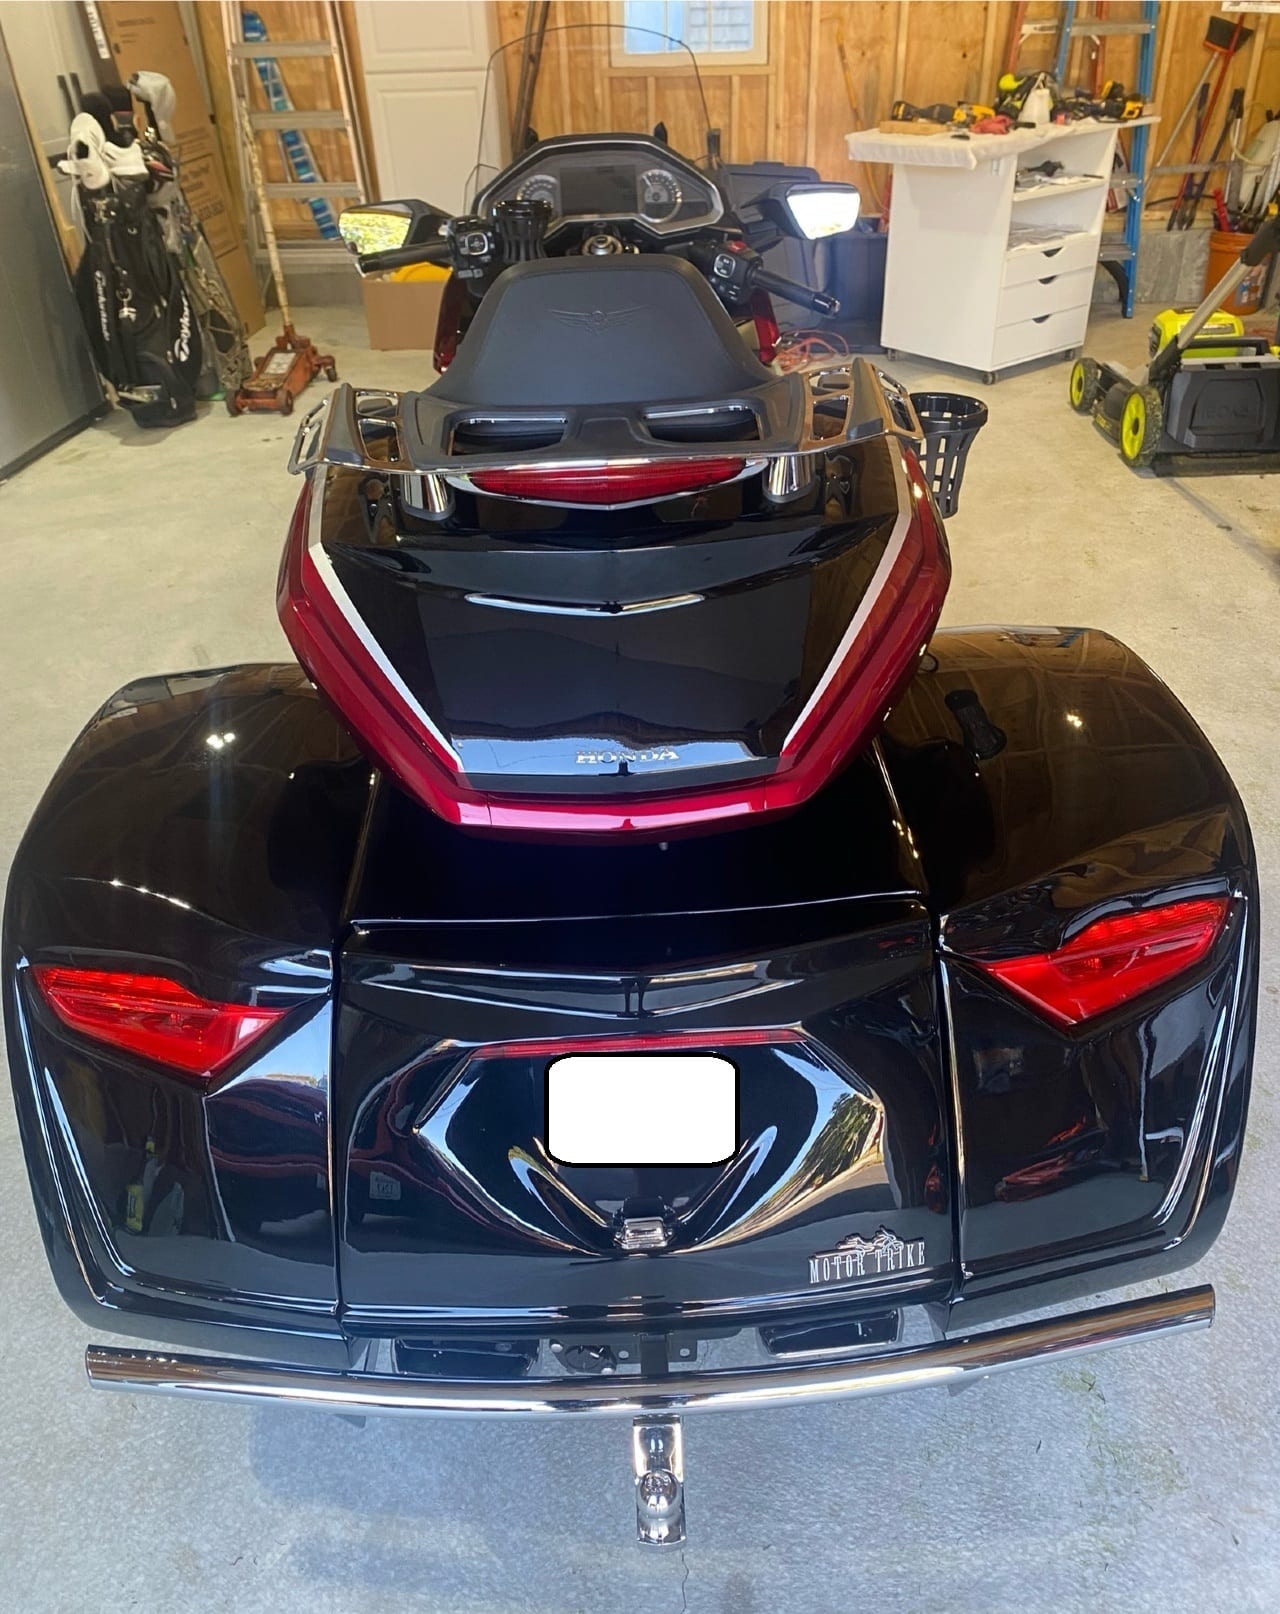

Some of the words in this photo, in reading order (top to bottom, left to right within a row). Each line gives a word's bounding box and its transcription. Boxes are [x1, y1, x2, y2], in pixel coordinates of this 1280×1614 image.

[576, 748, 679, 764] HONDA
[809, 1254, 866, 1284] MOTOR
[875, 1241, 925, 1273] TRIKE
